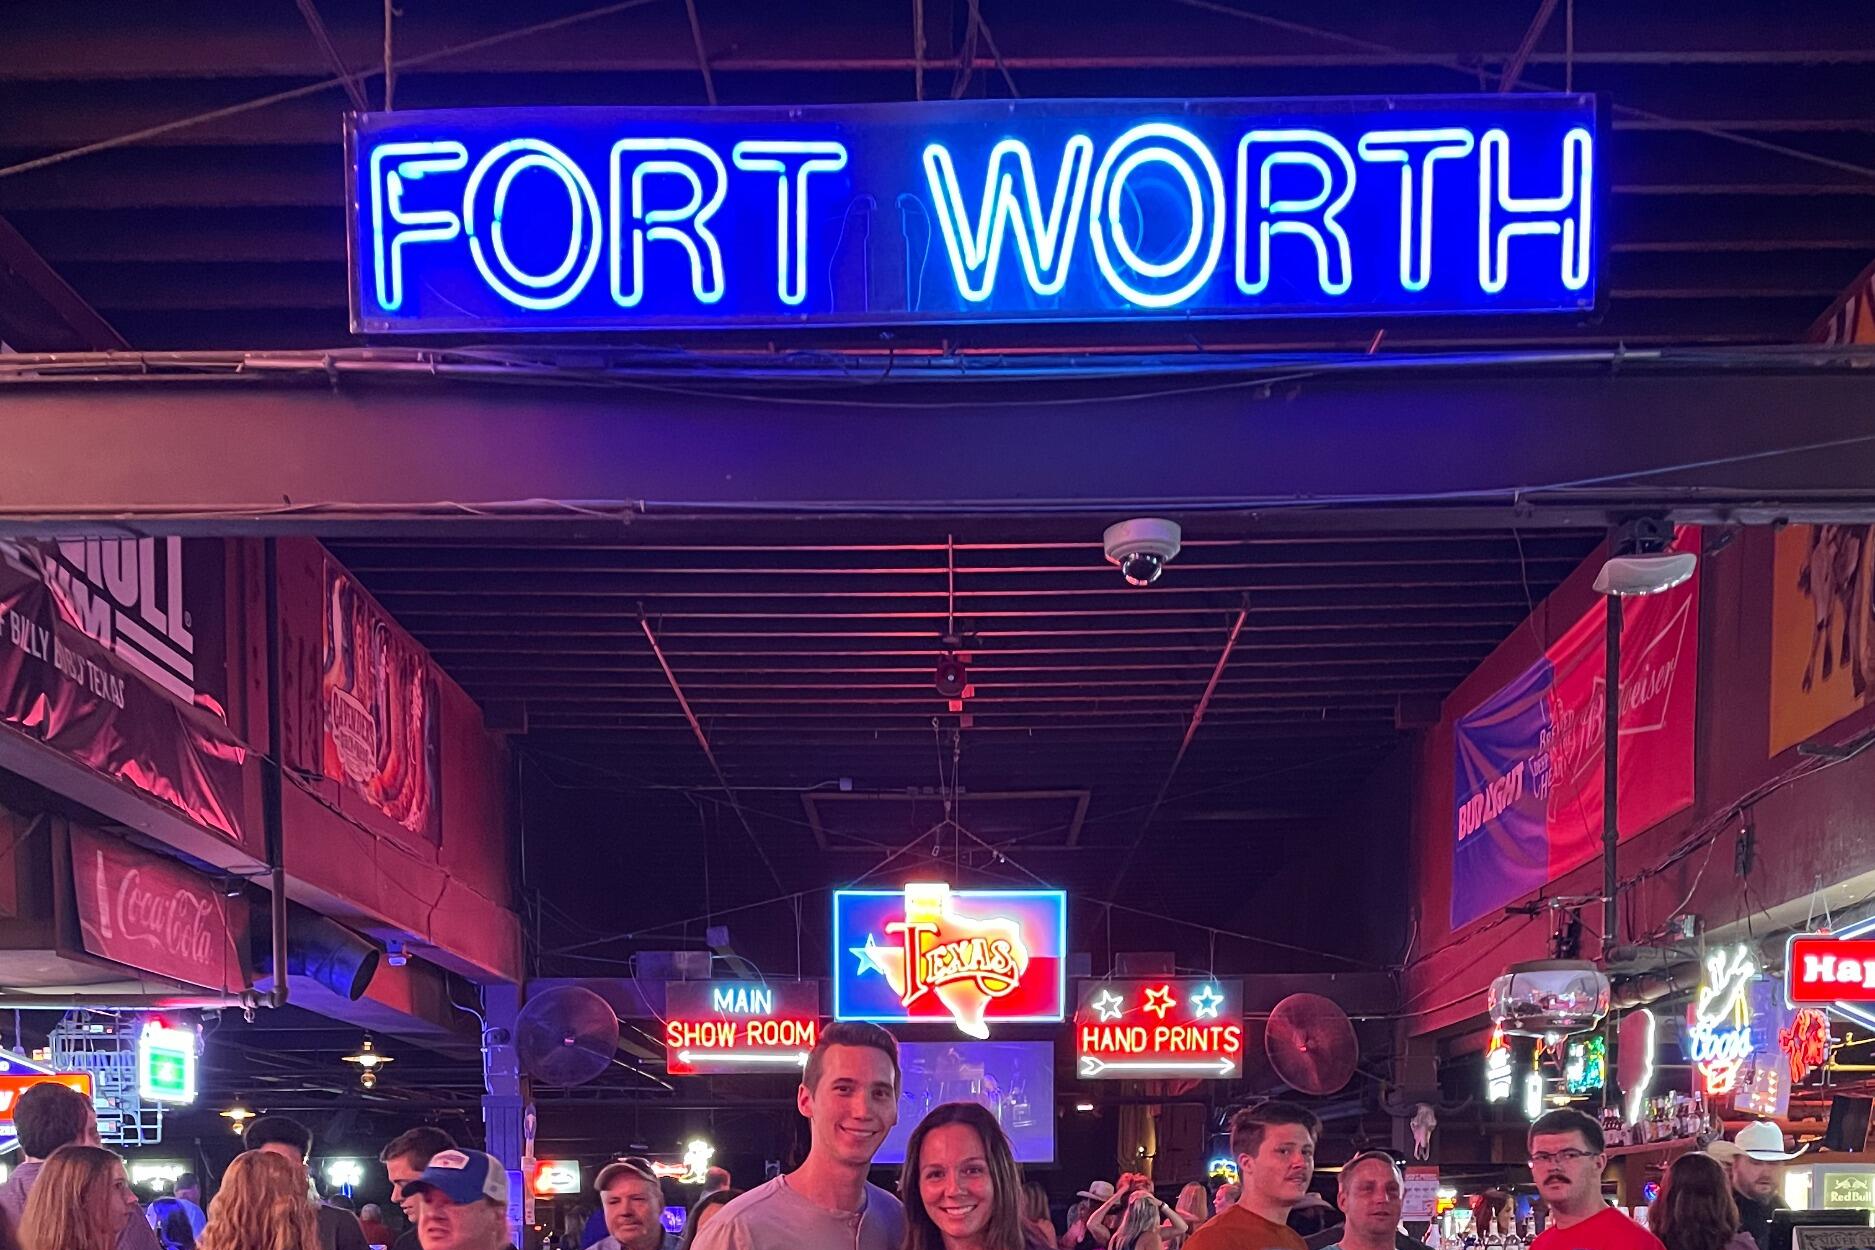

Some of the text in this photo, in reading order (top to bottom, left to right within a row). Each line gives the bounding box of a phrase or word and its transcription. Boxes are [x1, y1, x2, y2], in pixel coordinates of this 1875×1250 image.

[368, 121, 1596, 312] FORT WORTH
[10, 609, 49, 663] BILLY
[86, 659, 125, 709] TEXAS
[1459, 761, 1523, 841] BUD LIGHT
[713, 988, 772, 1015] MAIN
[667, 1020, 816, 1048] SHOW ROOM
[1082, 1026, 1241, 1053] HAND PRINTS
[1830, 1191, 1872, 1202] Red Bull
